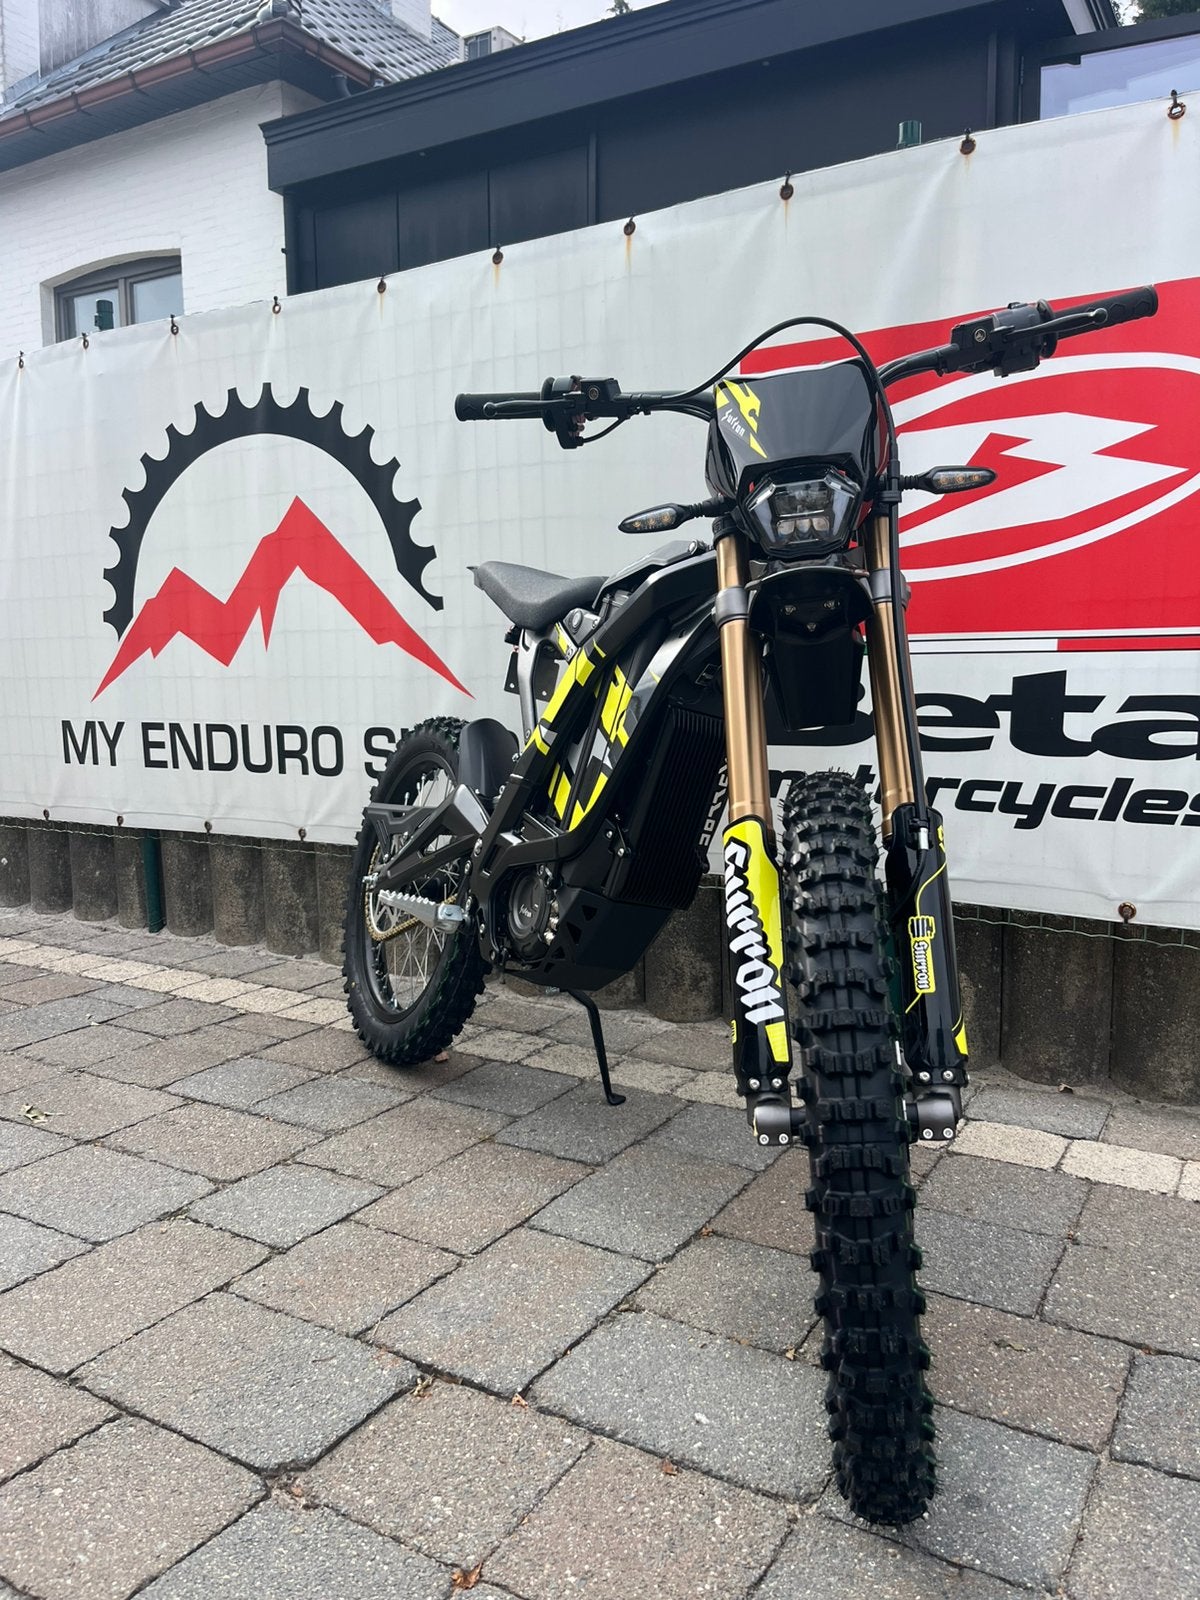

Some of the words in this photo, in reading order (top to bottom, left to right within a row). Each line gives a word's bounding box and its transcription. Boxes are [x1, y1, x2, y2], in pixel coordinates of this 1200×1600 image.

[763, 669, 1200, 761] eta
[61, 720, 125, 766] MY
[141, 722, 344, 777] ENDURO
[768, 764, 1200, 829] mtrcycle
